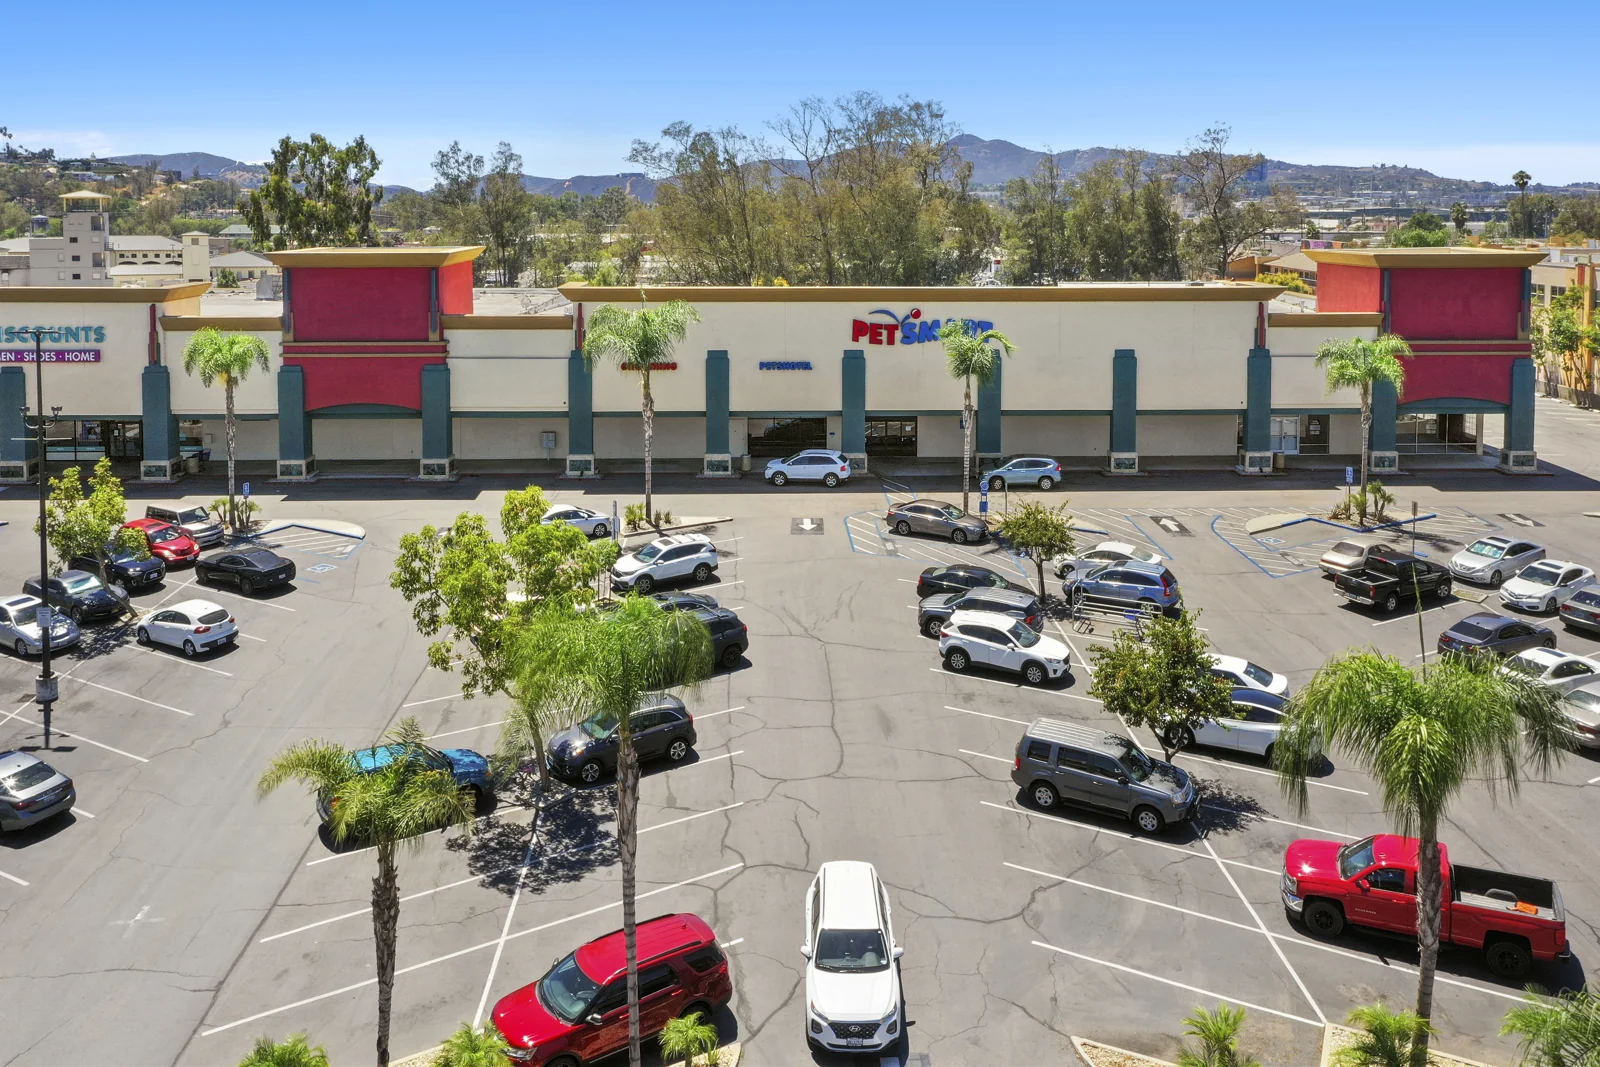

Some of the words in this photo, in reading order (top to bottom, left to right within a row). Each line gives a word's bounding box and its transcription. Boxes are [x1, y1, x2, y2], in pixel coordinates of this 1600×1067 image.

[852, 319, 994, 345] PETSMRT
[0, 352, 14, 361] EN
[65, 352, 95, 361] HOME
[759, 361, 812, 370] PETSHOTEL
